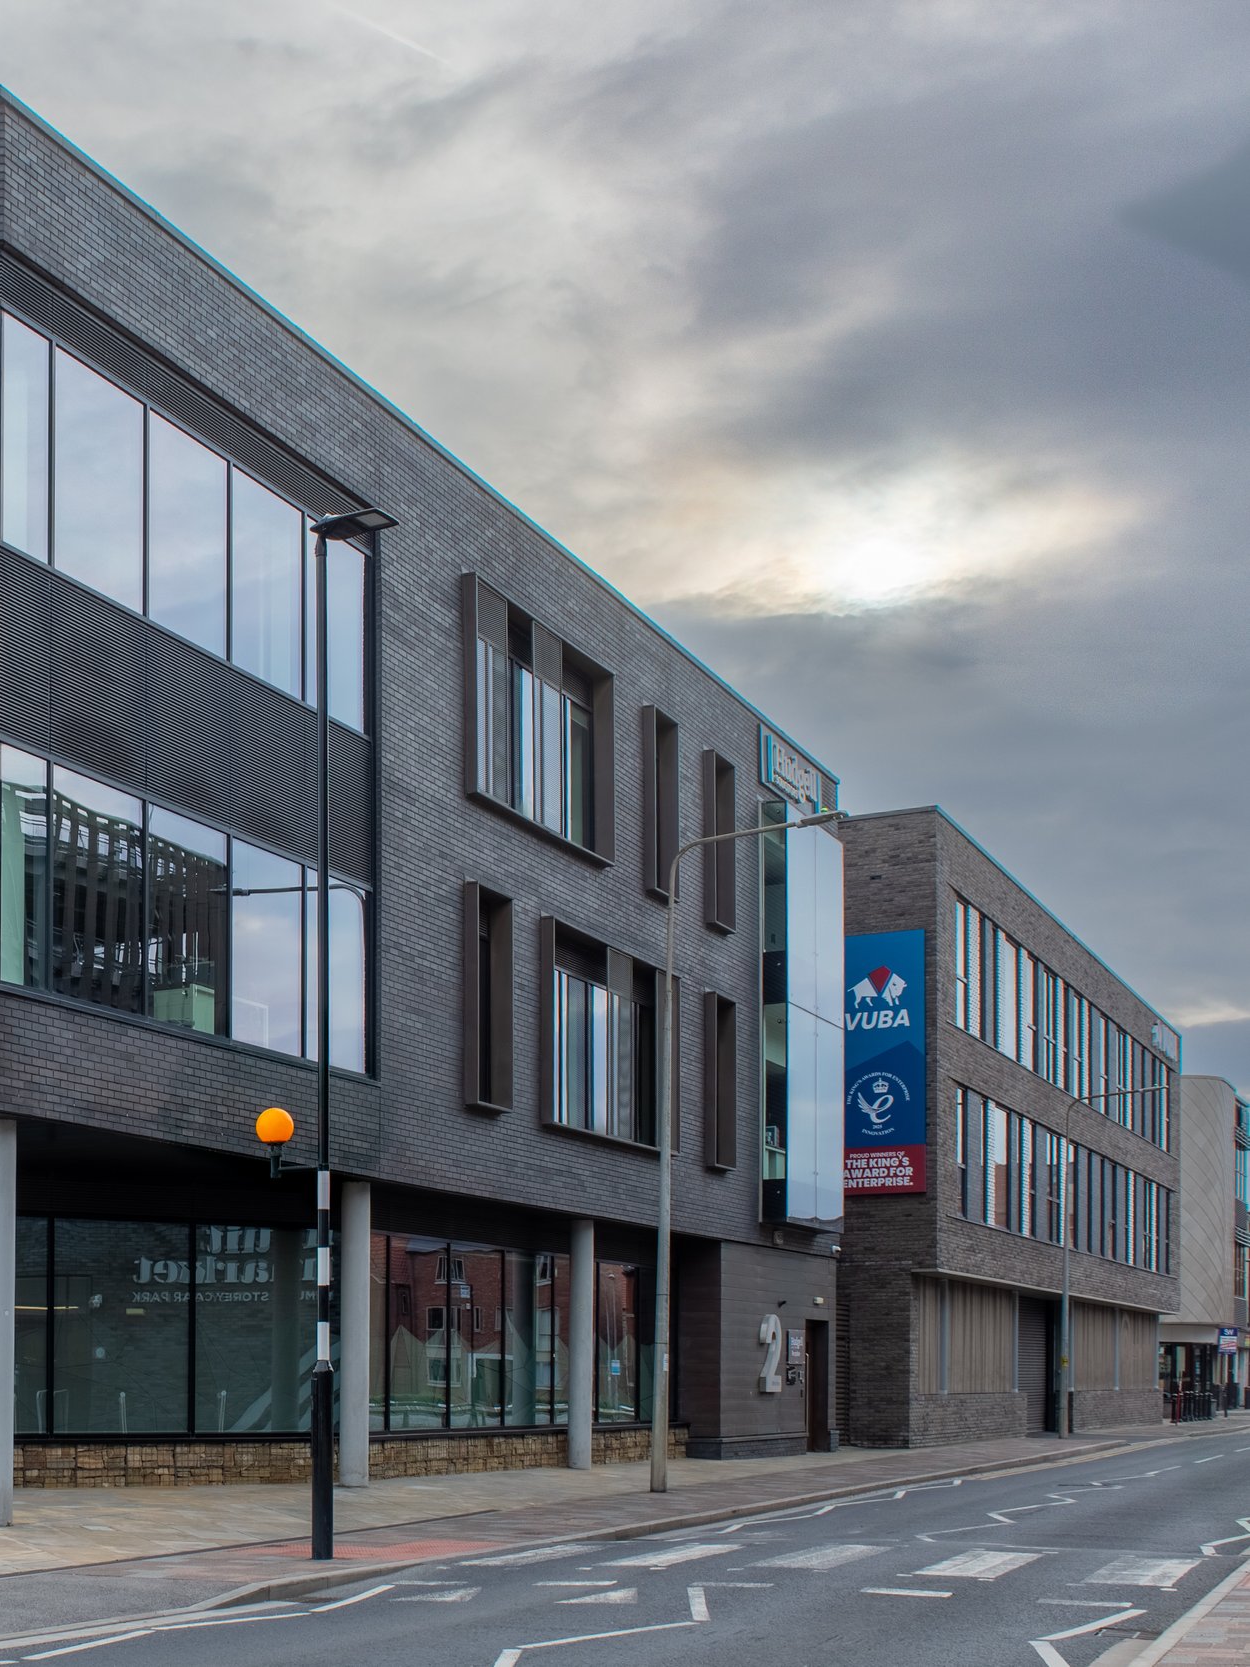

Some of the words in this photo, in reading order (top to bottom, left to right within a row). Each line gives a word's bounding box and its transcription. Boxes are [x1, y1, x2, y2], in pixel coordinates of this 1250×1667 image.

[845, 1008, 910, 1031] VUBA
[892, 1075, 910, 1101] ENTERPRISE
[861, 1127, 895, 1136] INNOVATION
[845, 1159, 868, 1169] THE
[869, 1156, 910, 1168] KING'S
[843, 1167, 888, 1178] AWARD
[889, 1167, 914, 1176] FOR
[843, 1177, 914, 1188] ENTERPRISE.
[760, 1313, 782, 1393] 2
